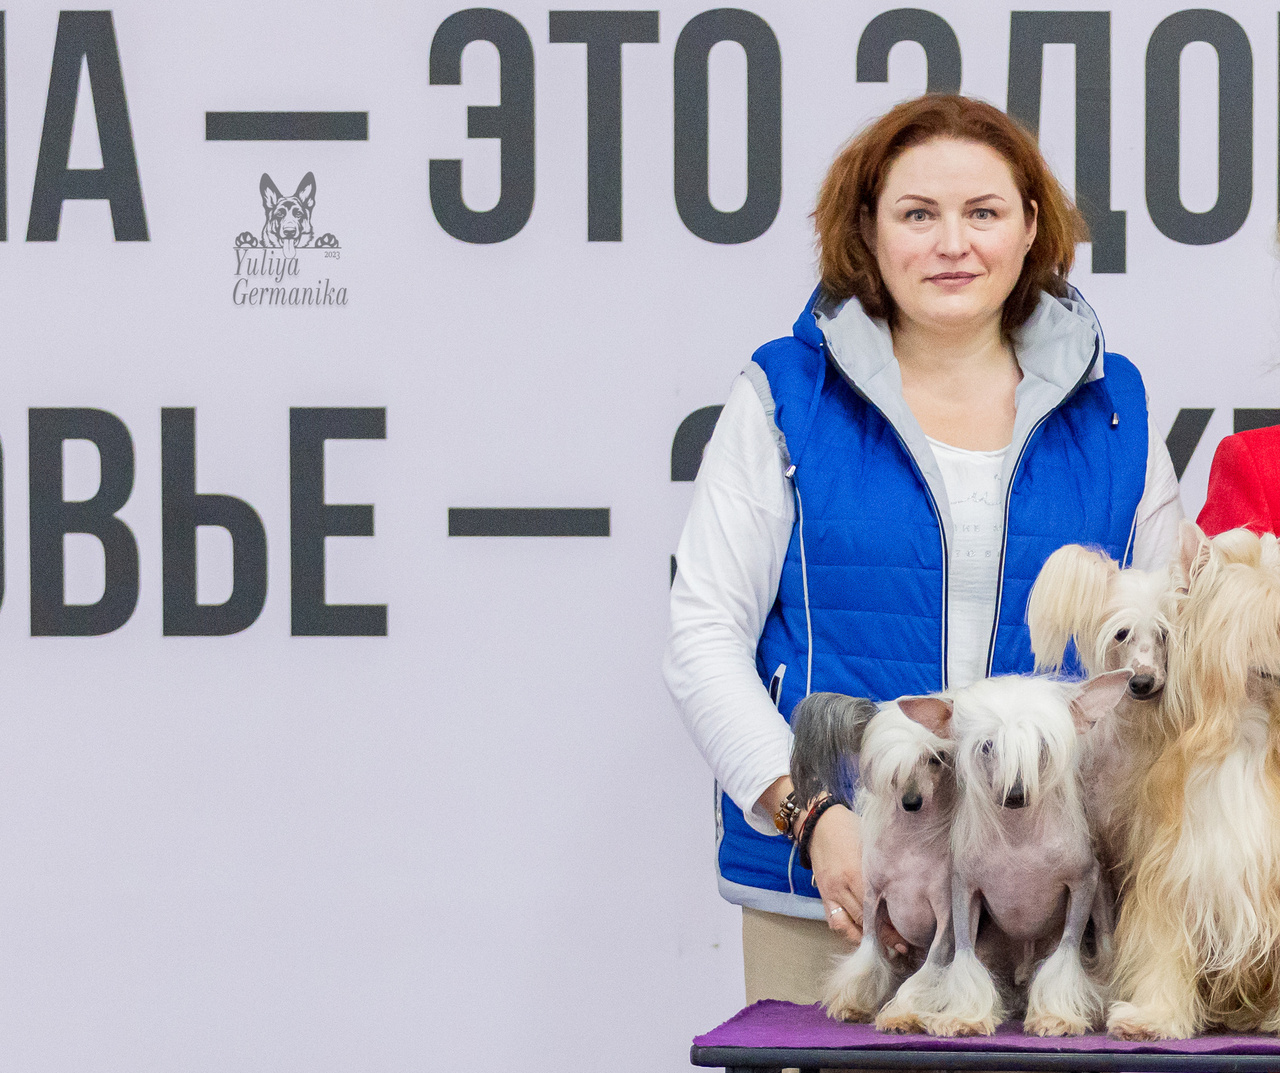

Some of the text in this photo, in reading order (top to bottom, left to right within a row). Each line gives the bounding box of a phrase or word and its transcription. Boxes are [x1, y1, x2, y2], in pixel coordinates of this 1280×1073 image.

[0, 10, 151, 242] А
[428, 8, 783, 245] ЭТО
[0, 407, 389, 638] ВЬЕ
